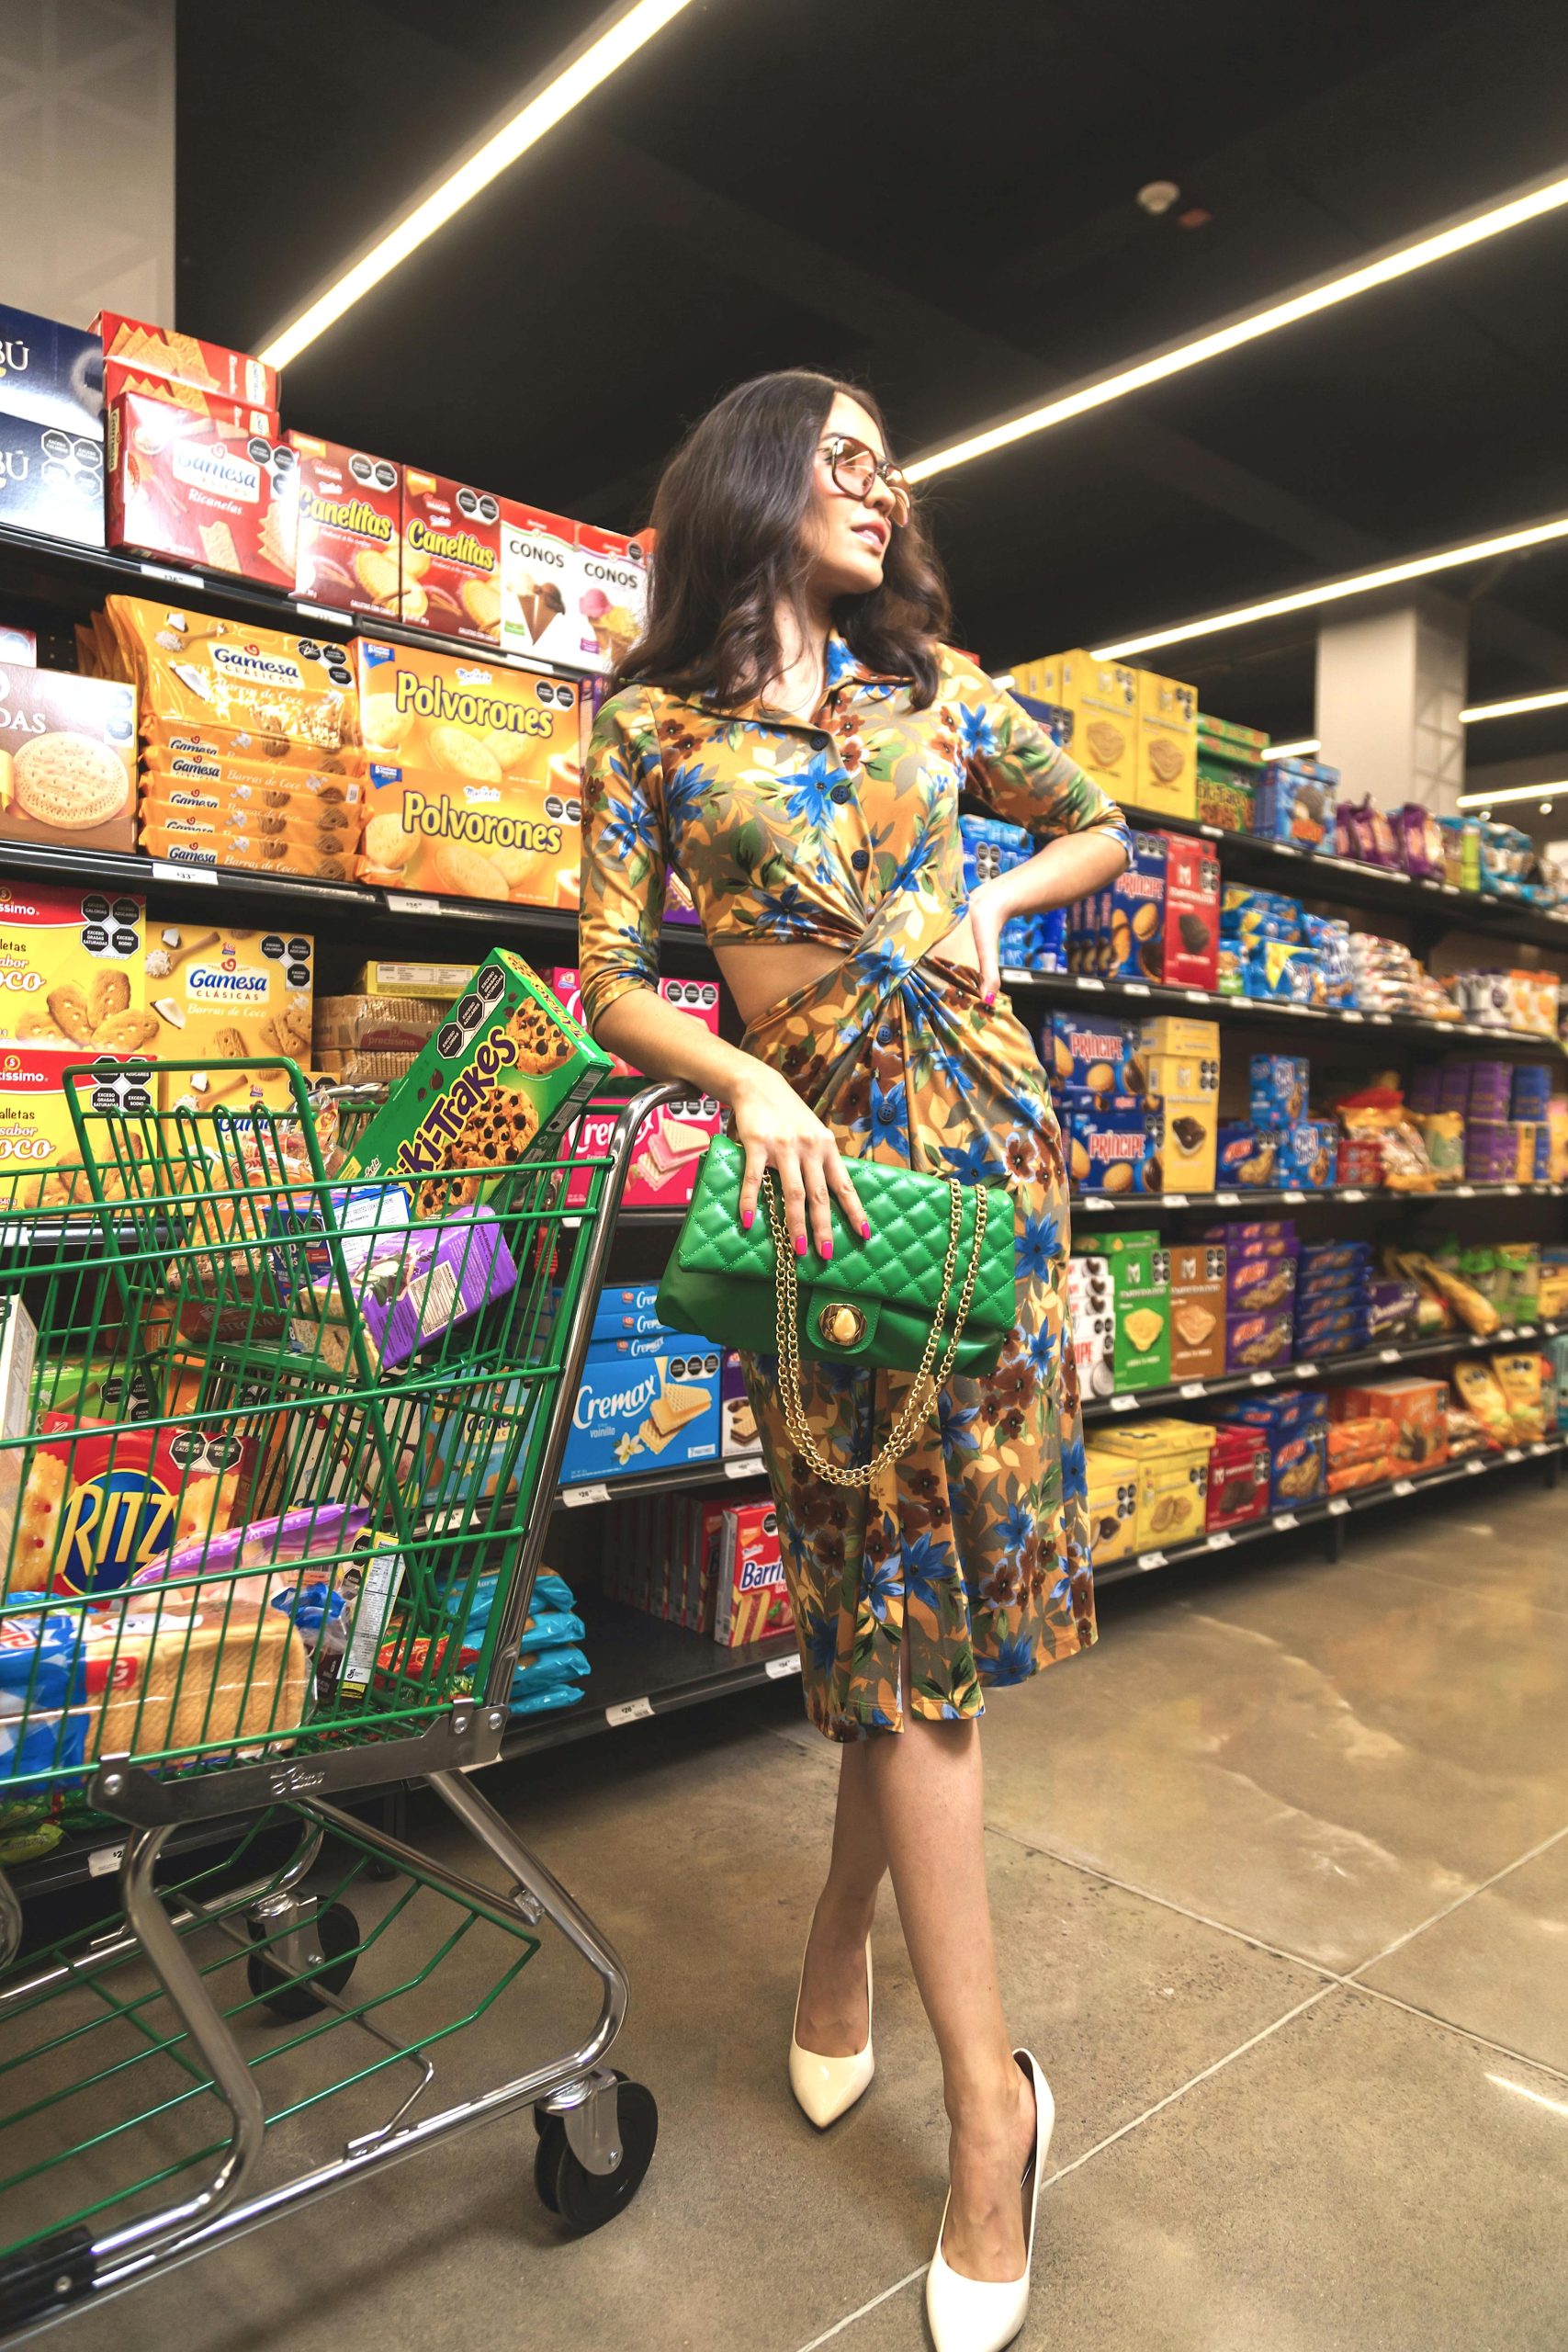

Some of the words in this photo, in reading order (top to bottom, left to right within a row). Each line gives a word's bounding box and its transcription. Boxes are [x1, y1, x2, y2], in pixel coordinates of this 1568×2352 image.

[188, 488, 243, 514] Ricanelas
[299, 485, 393, 543] Canelitas
[407, 517, 496, 572] Canelitas
[510, 539, 565, 569] CONOS
[584, 562, 638, 589] CONOS
[214, 648, 299, 678] Gamesa
[277, 691, 305, 706] Coco
[395, 670, 554, 739] Polvorones
[173, 760, 220, 777] Gamesa
[227, 769, 263, 784] Barras
[265, 775, 276, 787] de
[278, 778, 302, 790] Coco
[402, 788, 563, 855] Polvorones
[169, 847, 217, 864] Gamesa
[224, 855, 259, 869] Barras
[262, 861, 274, 871] de
[276, 863, 299, 873] Coco
[189, 969, 267, 992] Gamesa
[480, 970, 496, 989] EXCESO
[483, 975, 499, 992] GRASAS
[484, 974, 504, 1000] SATURADAS
[196, 989, 260, 1001] CLÁSICAS
[187, 1003, 224, 1015] Barras
[227, 1006, 239, 1016] de
[243, 1006, 267, 1018] Coco
[462, 1001, 476, 1020] EXCESO
[442, 1030, 456, 1048] EXCESO
[289, 1326, 296, 1340] 8
[631, 1336, 664, 1357] Cremax
[572, 1374, 658, 1430] Cremax
[57, 1483, 179, 1577] RITZ
[107, 1659, 130, 1683] G
